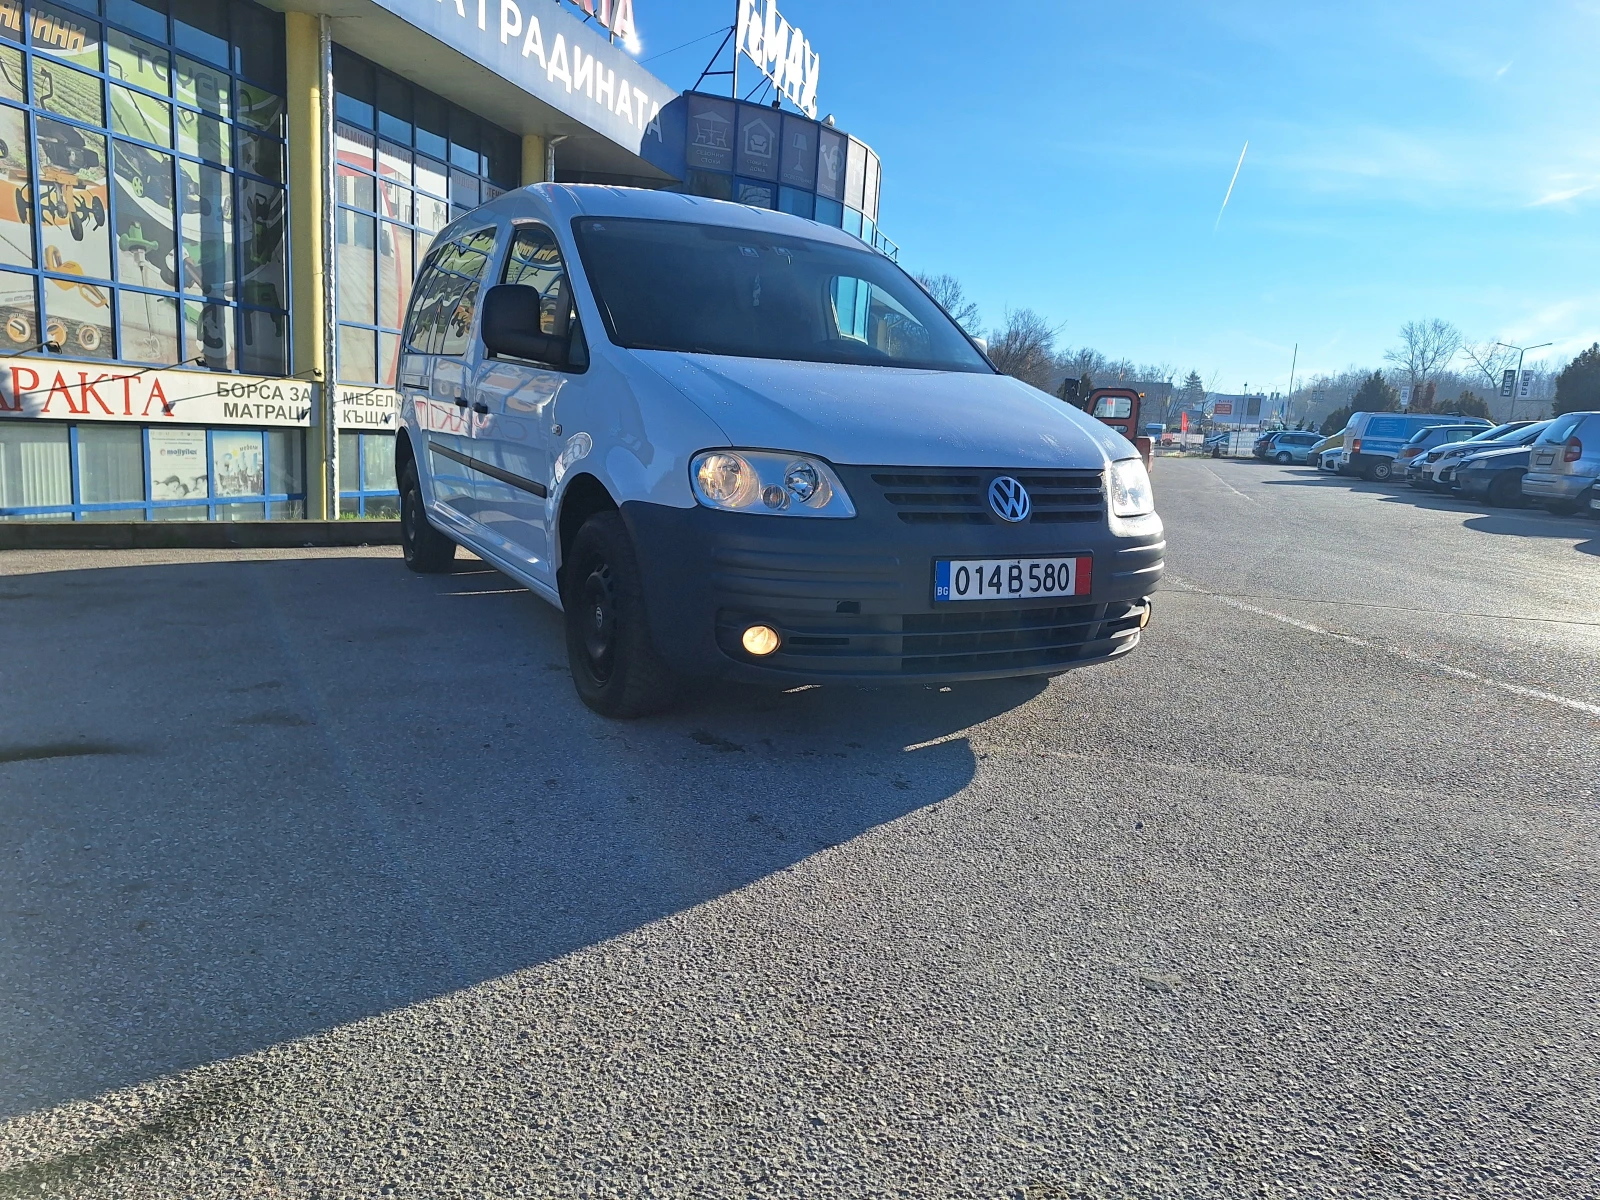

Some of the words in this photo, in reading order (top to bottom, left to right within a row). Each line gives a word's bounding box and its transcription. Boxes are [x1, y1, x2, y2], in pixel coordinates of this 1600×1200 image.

[217, 381, 284, 401] БОРСА
[290, 387, 312, 402] ЗА
[937, 586, 949, 596] BG
